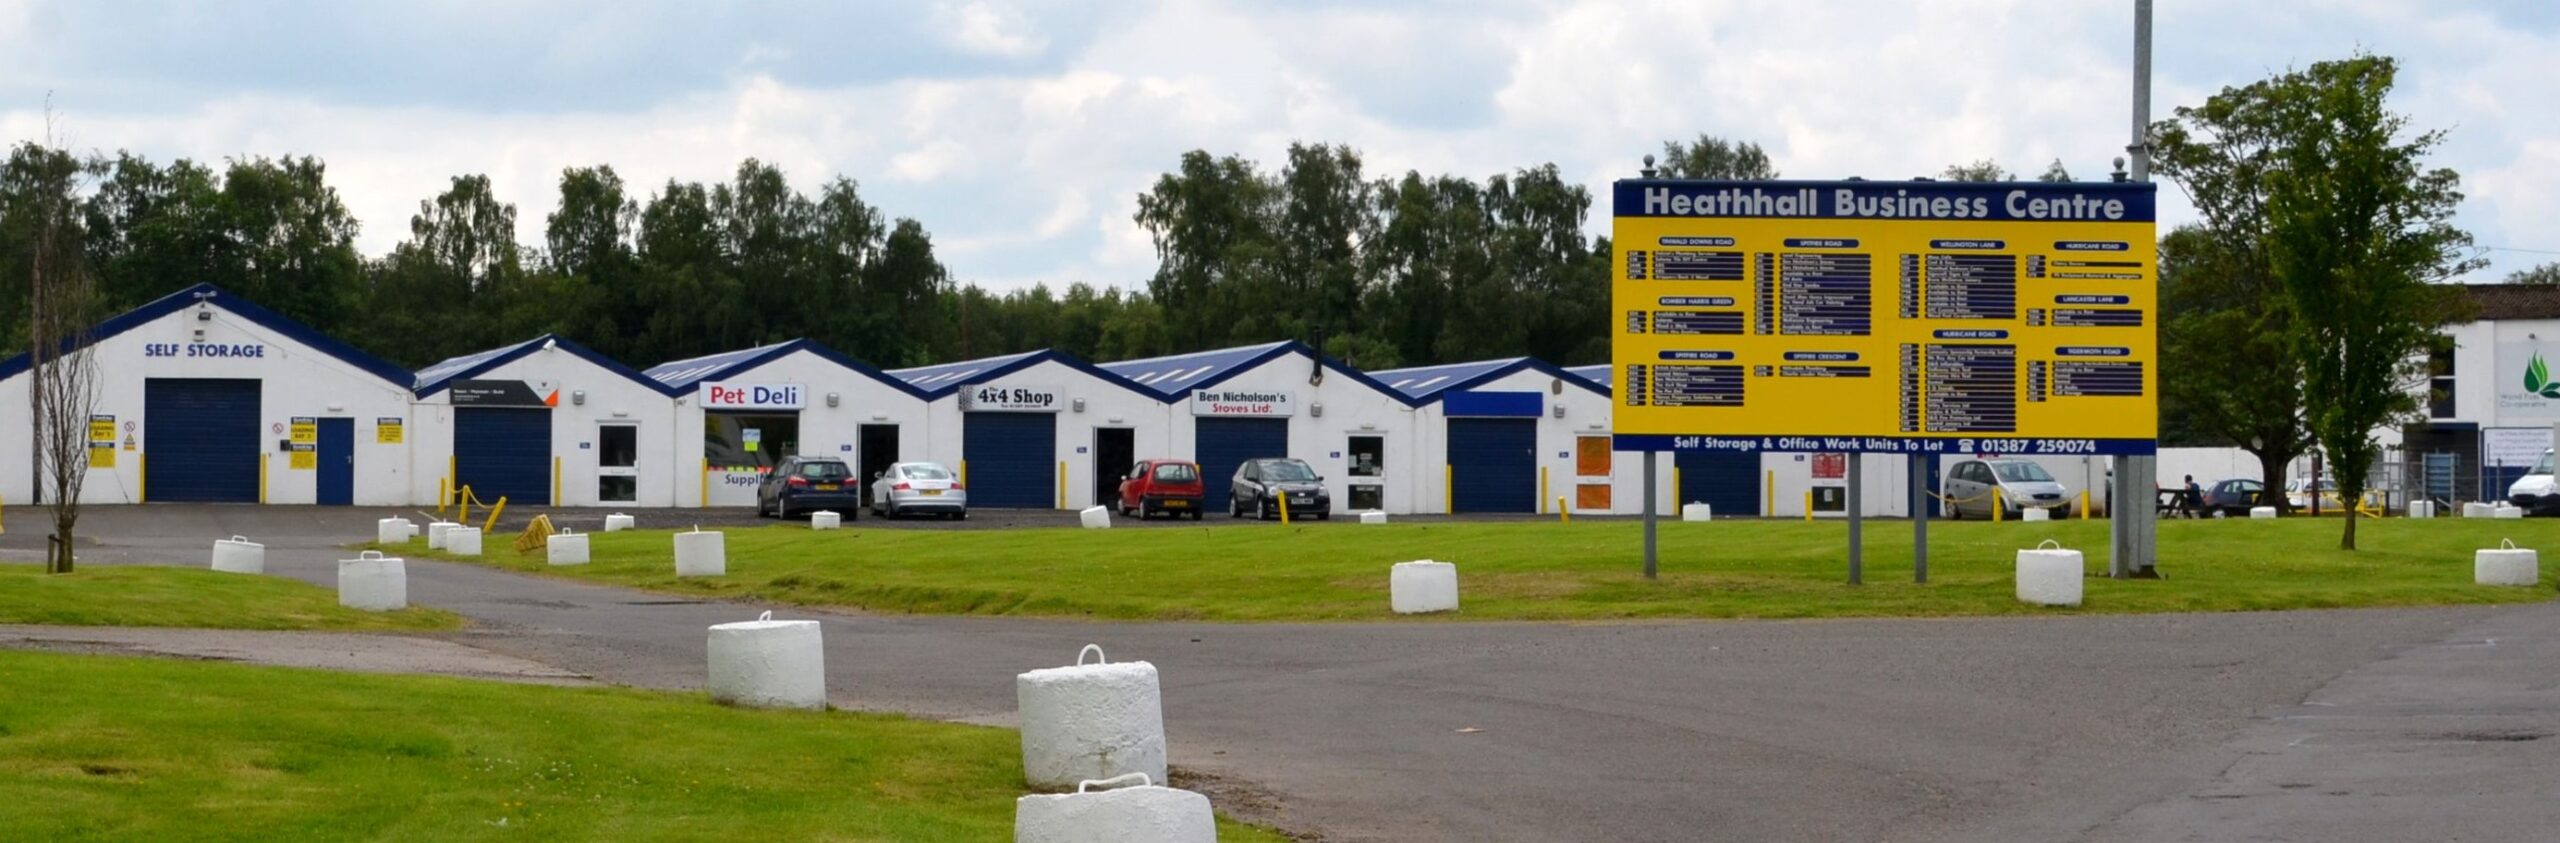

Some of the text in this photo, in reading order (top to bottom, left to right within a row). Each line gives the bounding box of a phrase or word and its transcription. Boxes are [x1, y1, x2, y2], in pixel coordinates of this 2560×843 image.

[1645, 188, 2124, 220] Heathhall Business Centre
[145, 343, 264, 358] SELF STORAGE
[710, 386, 797, 404] Pet Deli
[978, 388, 1054, 407] 4x4 Shop
[1199, 392, 1286, 402] Ben Nicholson's
[1212, 403, 1249, 413] Stoves
[1674, 437, 2096, 453] Self Storage & Office Work Units To Let 01387 259074
